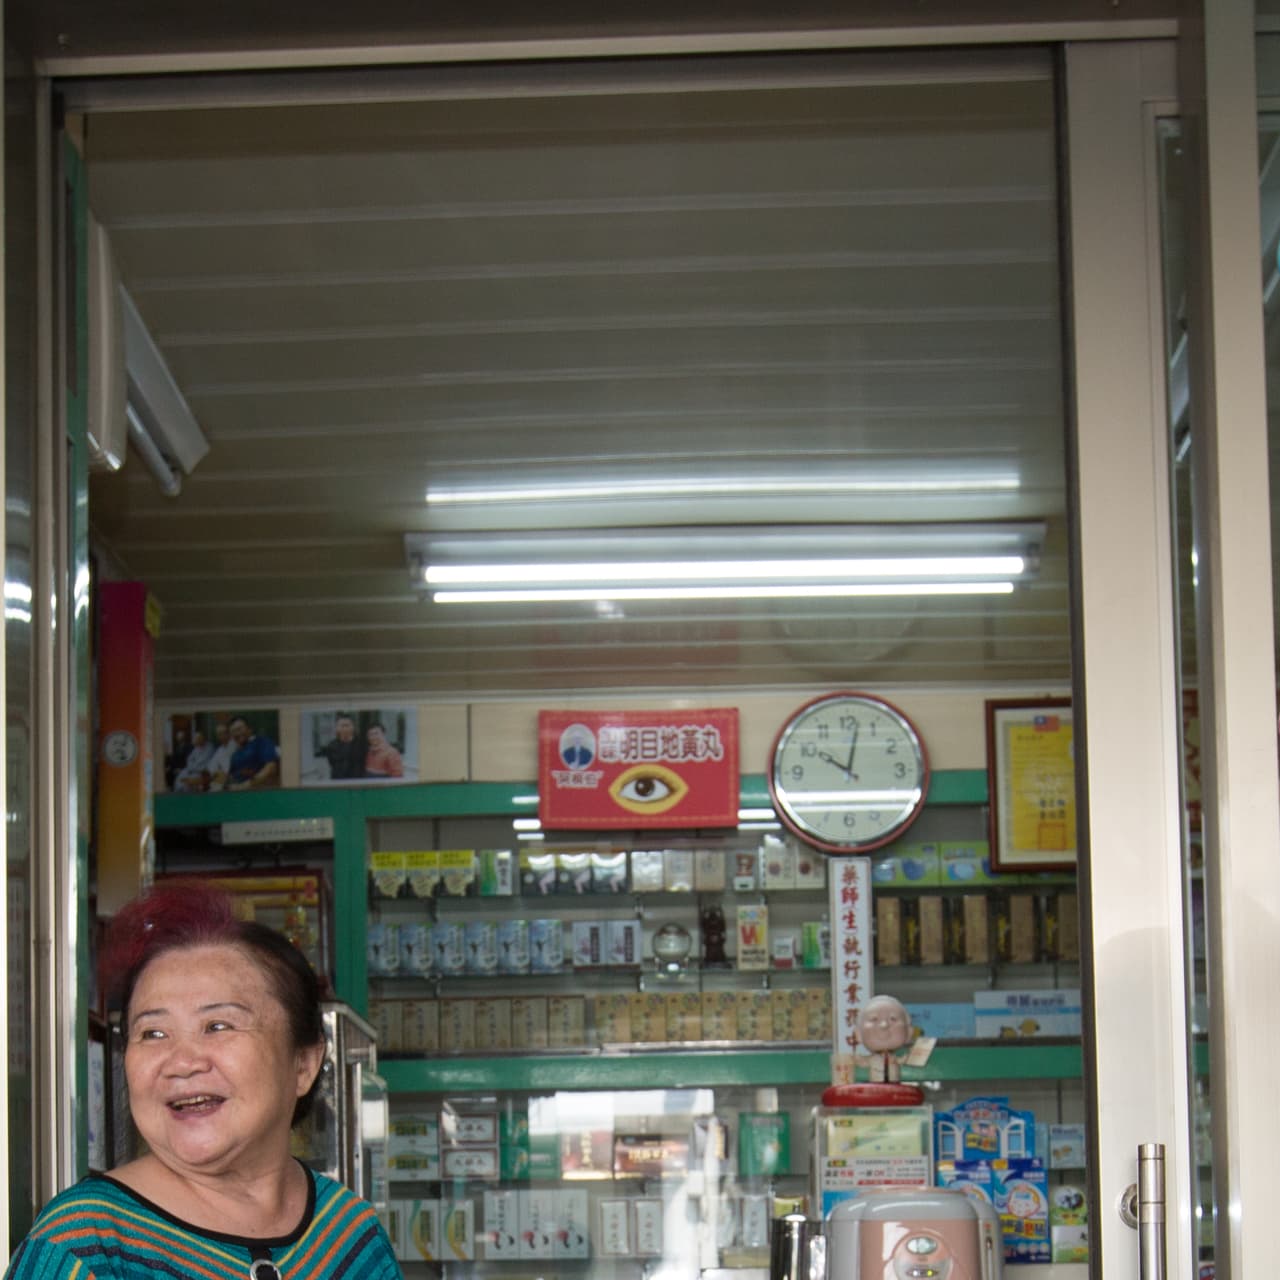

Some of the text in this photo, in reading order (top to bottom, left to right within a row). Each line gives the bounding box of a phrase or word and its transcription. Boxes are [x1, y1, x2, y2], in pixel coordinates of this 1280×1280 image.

[840, 717, 855, 730] 12
[620, 727, 724, 762] 明目地黃丸
[800, 740, 897, 757] 10 2
[793, 762, 906, 780] 9 3
[844, 813, 855, 828] 6
